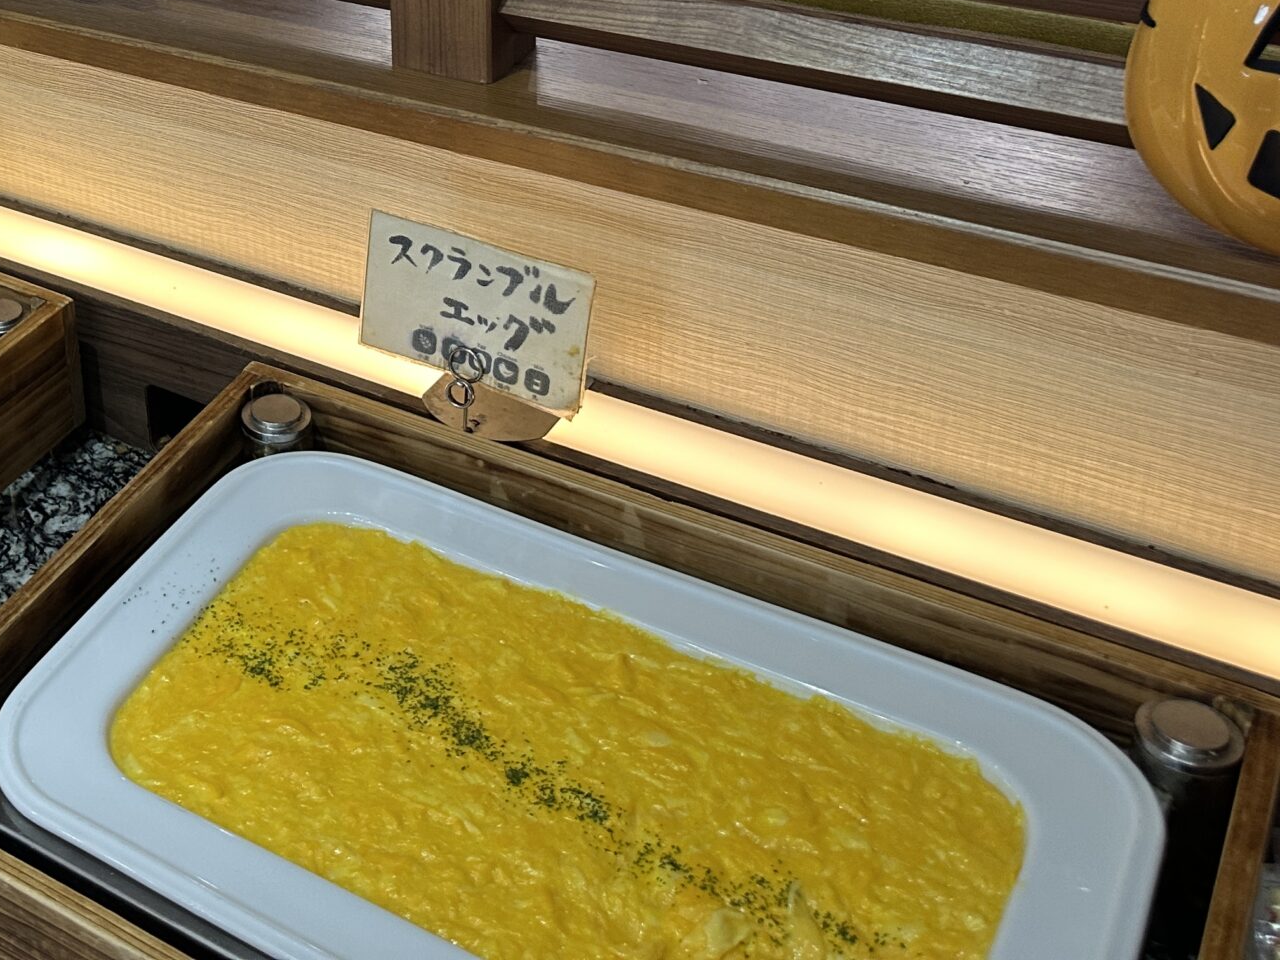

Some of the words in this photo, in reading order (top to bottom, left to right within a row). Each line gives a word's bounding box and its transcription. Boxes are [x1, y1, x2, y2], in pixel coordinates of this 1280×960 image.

[388, 234, 576, 315] スクランブル
[439, 296, 556, 352] エッグ
